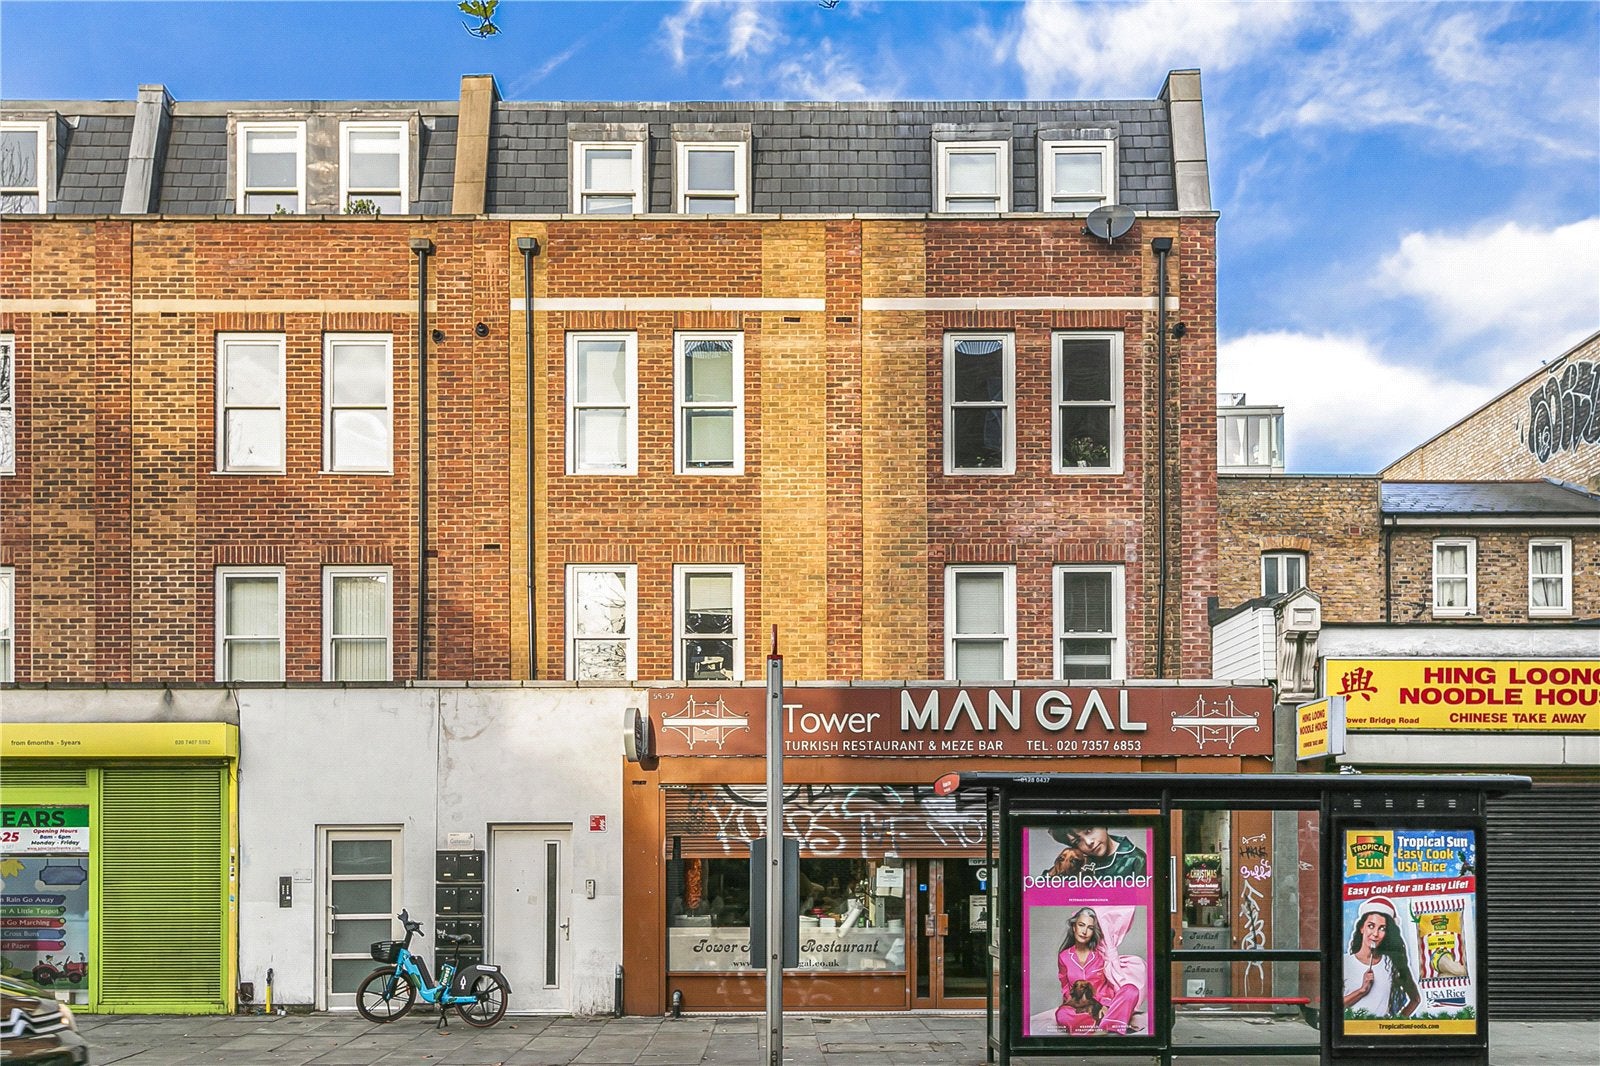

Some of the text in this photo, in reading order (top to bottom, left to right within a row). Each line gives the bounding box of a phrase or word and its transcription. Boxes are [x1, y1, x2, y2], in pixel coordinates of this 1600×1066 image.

[1424, 667, 1496, 685] HING
[1336, 667, 1378, 702] 興
[1400, 688, 1600, 706] NOODLE HOU
[783, 704, 881, 734] Tower
[1302, 709, 1325, 723] HING LOONG
[1370, 716, 1396, 726] Bridge
[1450, 713, 1586, 724] CHINESE TAKE AWAY
[1300, 720, 1328, 736] NOODLE HOUSE
[785, 740, 1004, 751] TURKISH RESTAURANT & MEZE BAR
[1026, 740, 1142, 751] TEL: 020 7357 6853
[0, 832, 20, 842] 25
[1397, 836, 1468, 849] Tropical Sun
[1352, 843, 1388, 854] TROPICAL
[1397, 848, 1454, 861] Easy Cook
[1358, 858, 1382, 868] SUN
[1397, 862, 1446, 872] USA Rice
[1023, 872, 1153, 892] peteralexander
[1348, 886, 1369, 896] Easy
[1371, 885, 1393, 894] Cook
[1395, 884, 1410, 892] for
[1425, 882, 1446, 892] Easy
[1448, 880, 1469, 889] Life!
[693, 939, 738, 953] Tower
[800, 939, 880, 953] Restaurant
[1426, 989, 1466, 1000] USA Rice
